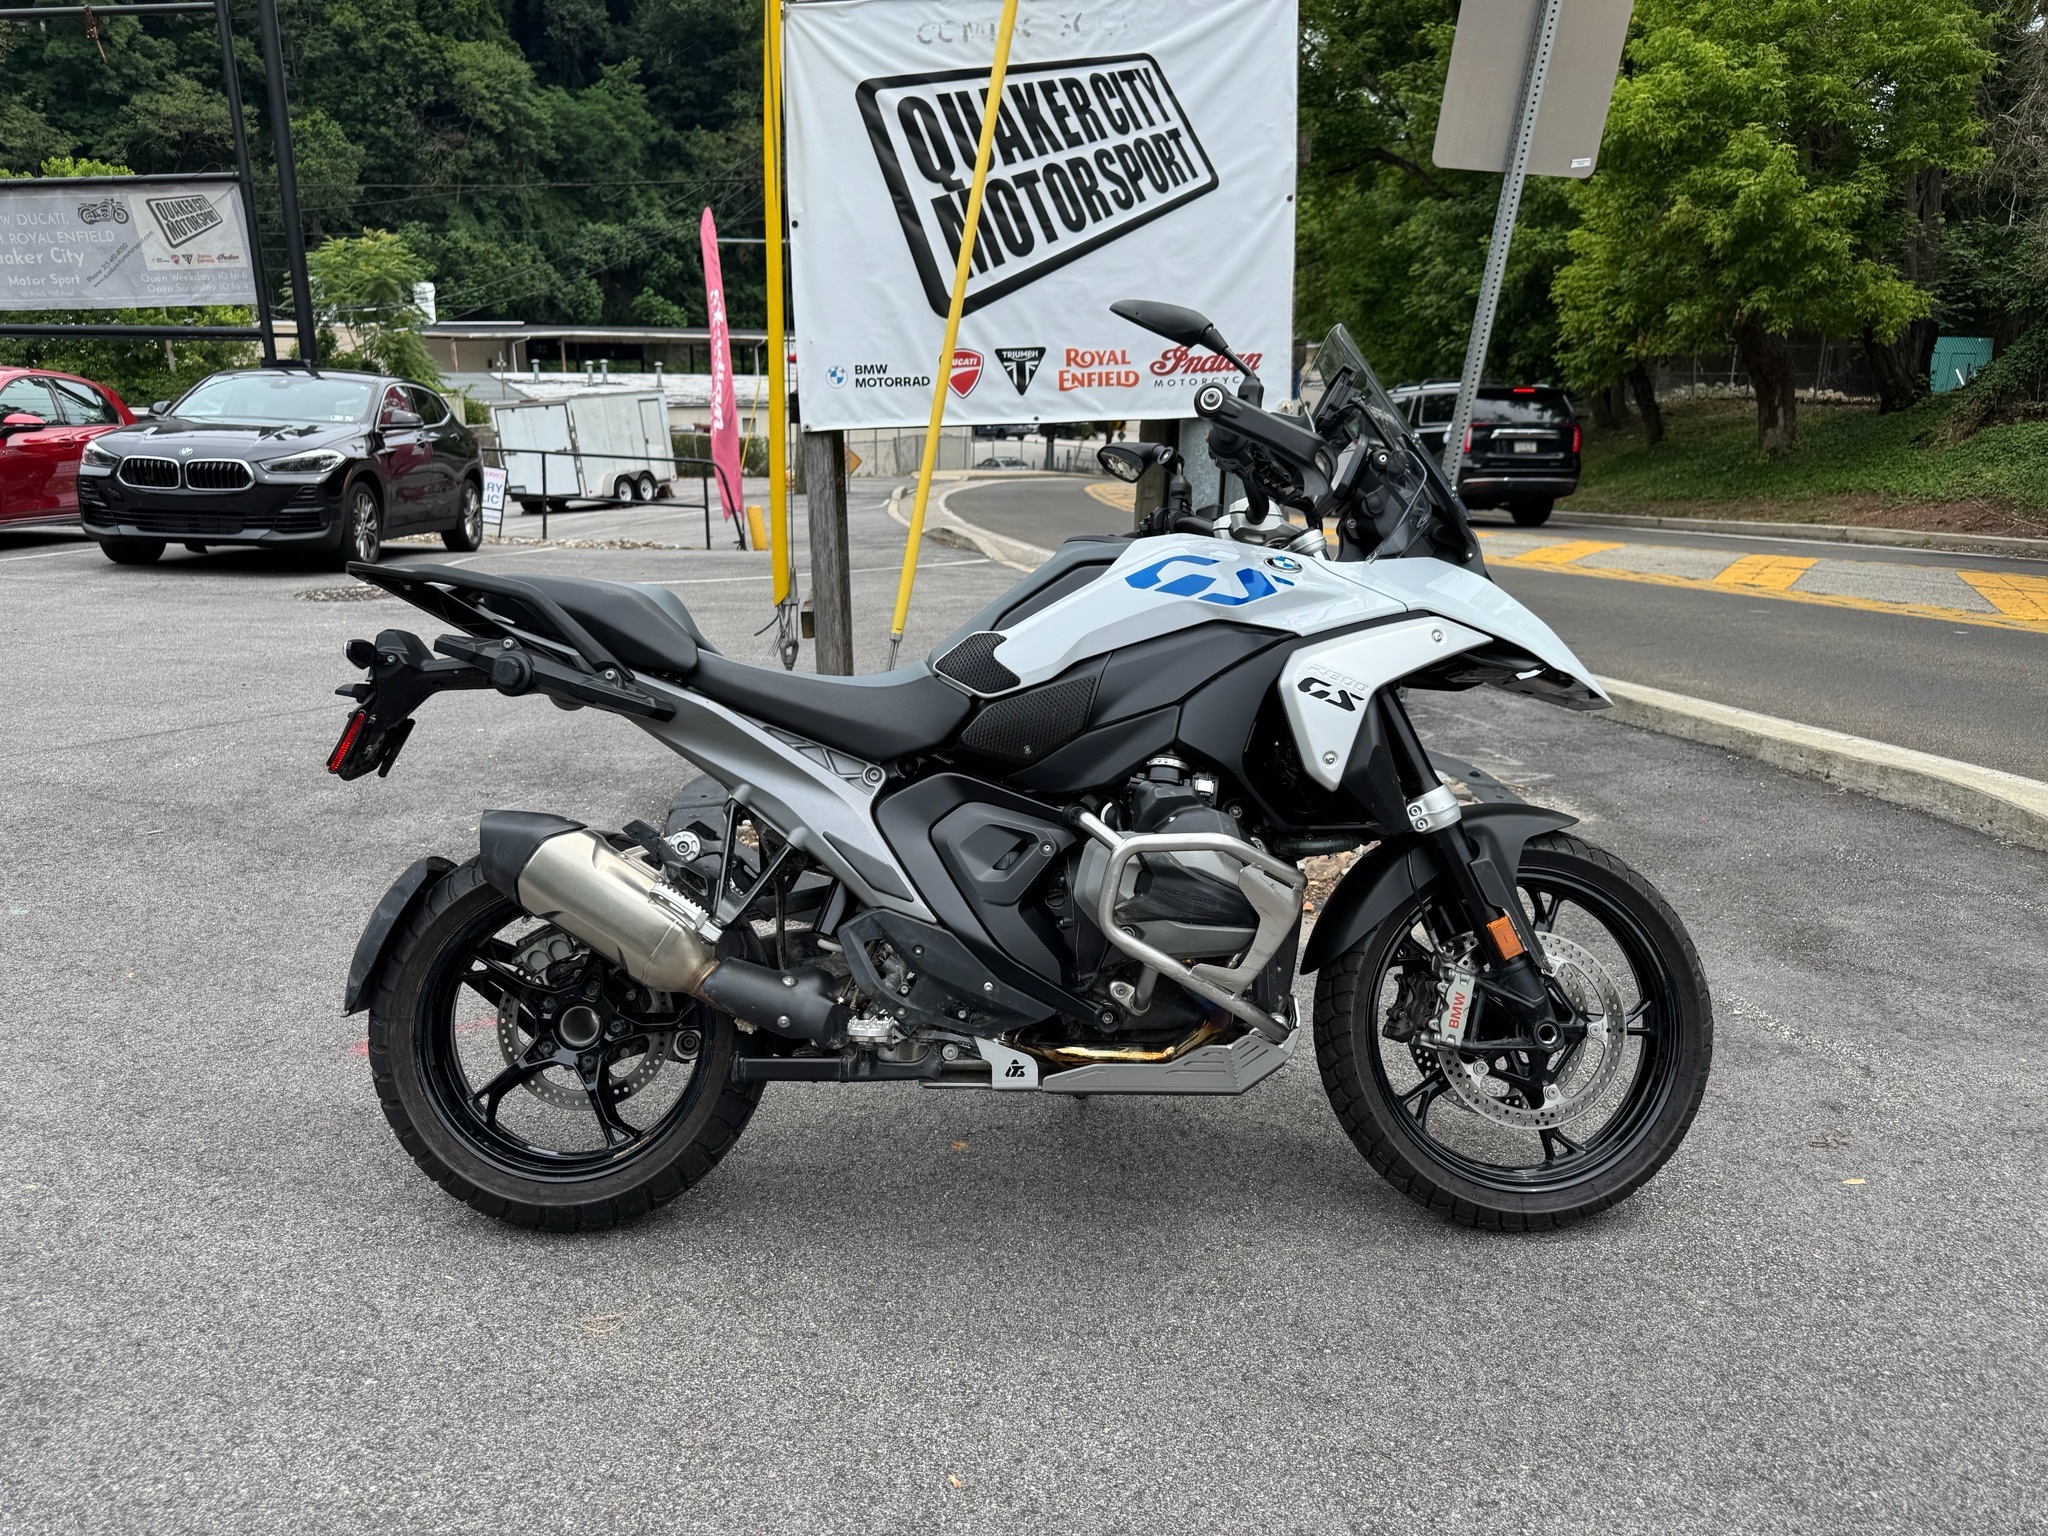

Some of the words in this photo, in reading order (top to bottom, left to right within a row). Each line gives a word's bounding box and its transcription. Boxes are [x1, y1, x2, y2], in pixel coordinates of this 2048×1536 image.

[896, 76, 1110, 192] QUAKER
[1095, 67, 1172, 140] CITY
[155, 199, 195, 222] QUAKER
[931, 127, 1199, 279] MOTORSPORT
[17, 212, 69, 226] DUCATI,
[166, 209, 219, 241] MOTORSPORT
[9, 232, 55, 245] ROYAL
[57, 230, 115, 243] ENFIELD
[50, 247, 85, 267] City
[8, 274, 46, 286] Motor
[50, 273, 81, 287] Sport
[141, 273, 168, 284] Open
[170, 272, 215, 282] Weekdays
[217, 271, 228, 280] 10
[147, 284, 173, 294] Open
[175, 283, 217, 293] Saturday
[219, 282, 229, 291] 10
[952, 357, 977, 367] UCATI
[1002, 350, 1039, 359] TRIUMPH
[1065, 348, 1132, 369] ROYAL
[854, 364, 888, 374] BMW
[855, 376, 930, 388] MOTORRAD
[1058, 370, 1140, 392] ENFIELD
[1125, 555, 1295, 606] GS
[1297, 677, 1365, 711] GS
[1448, 991, 1466, 1029] BMW
